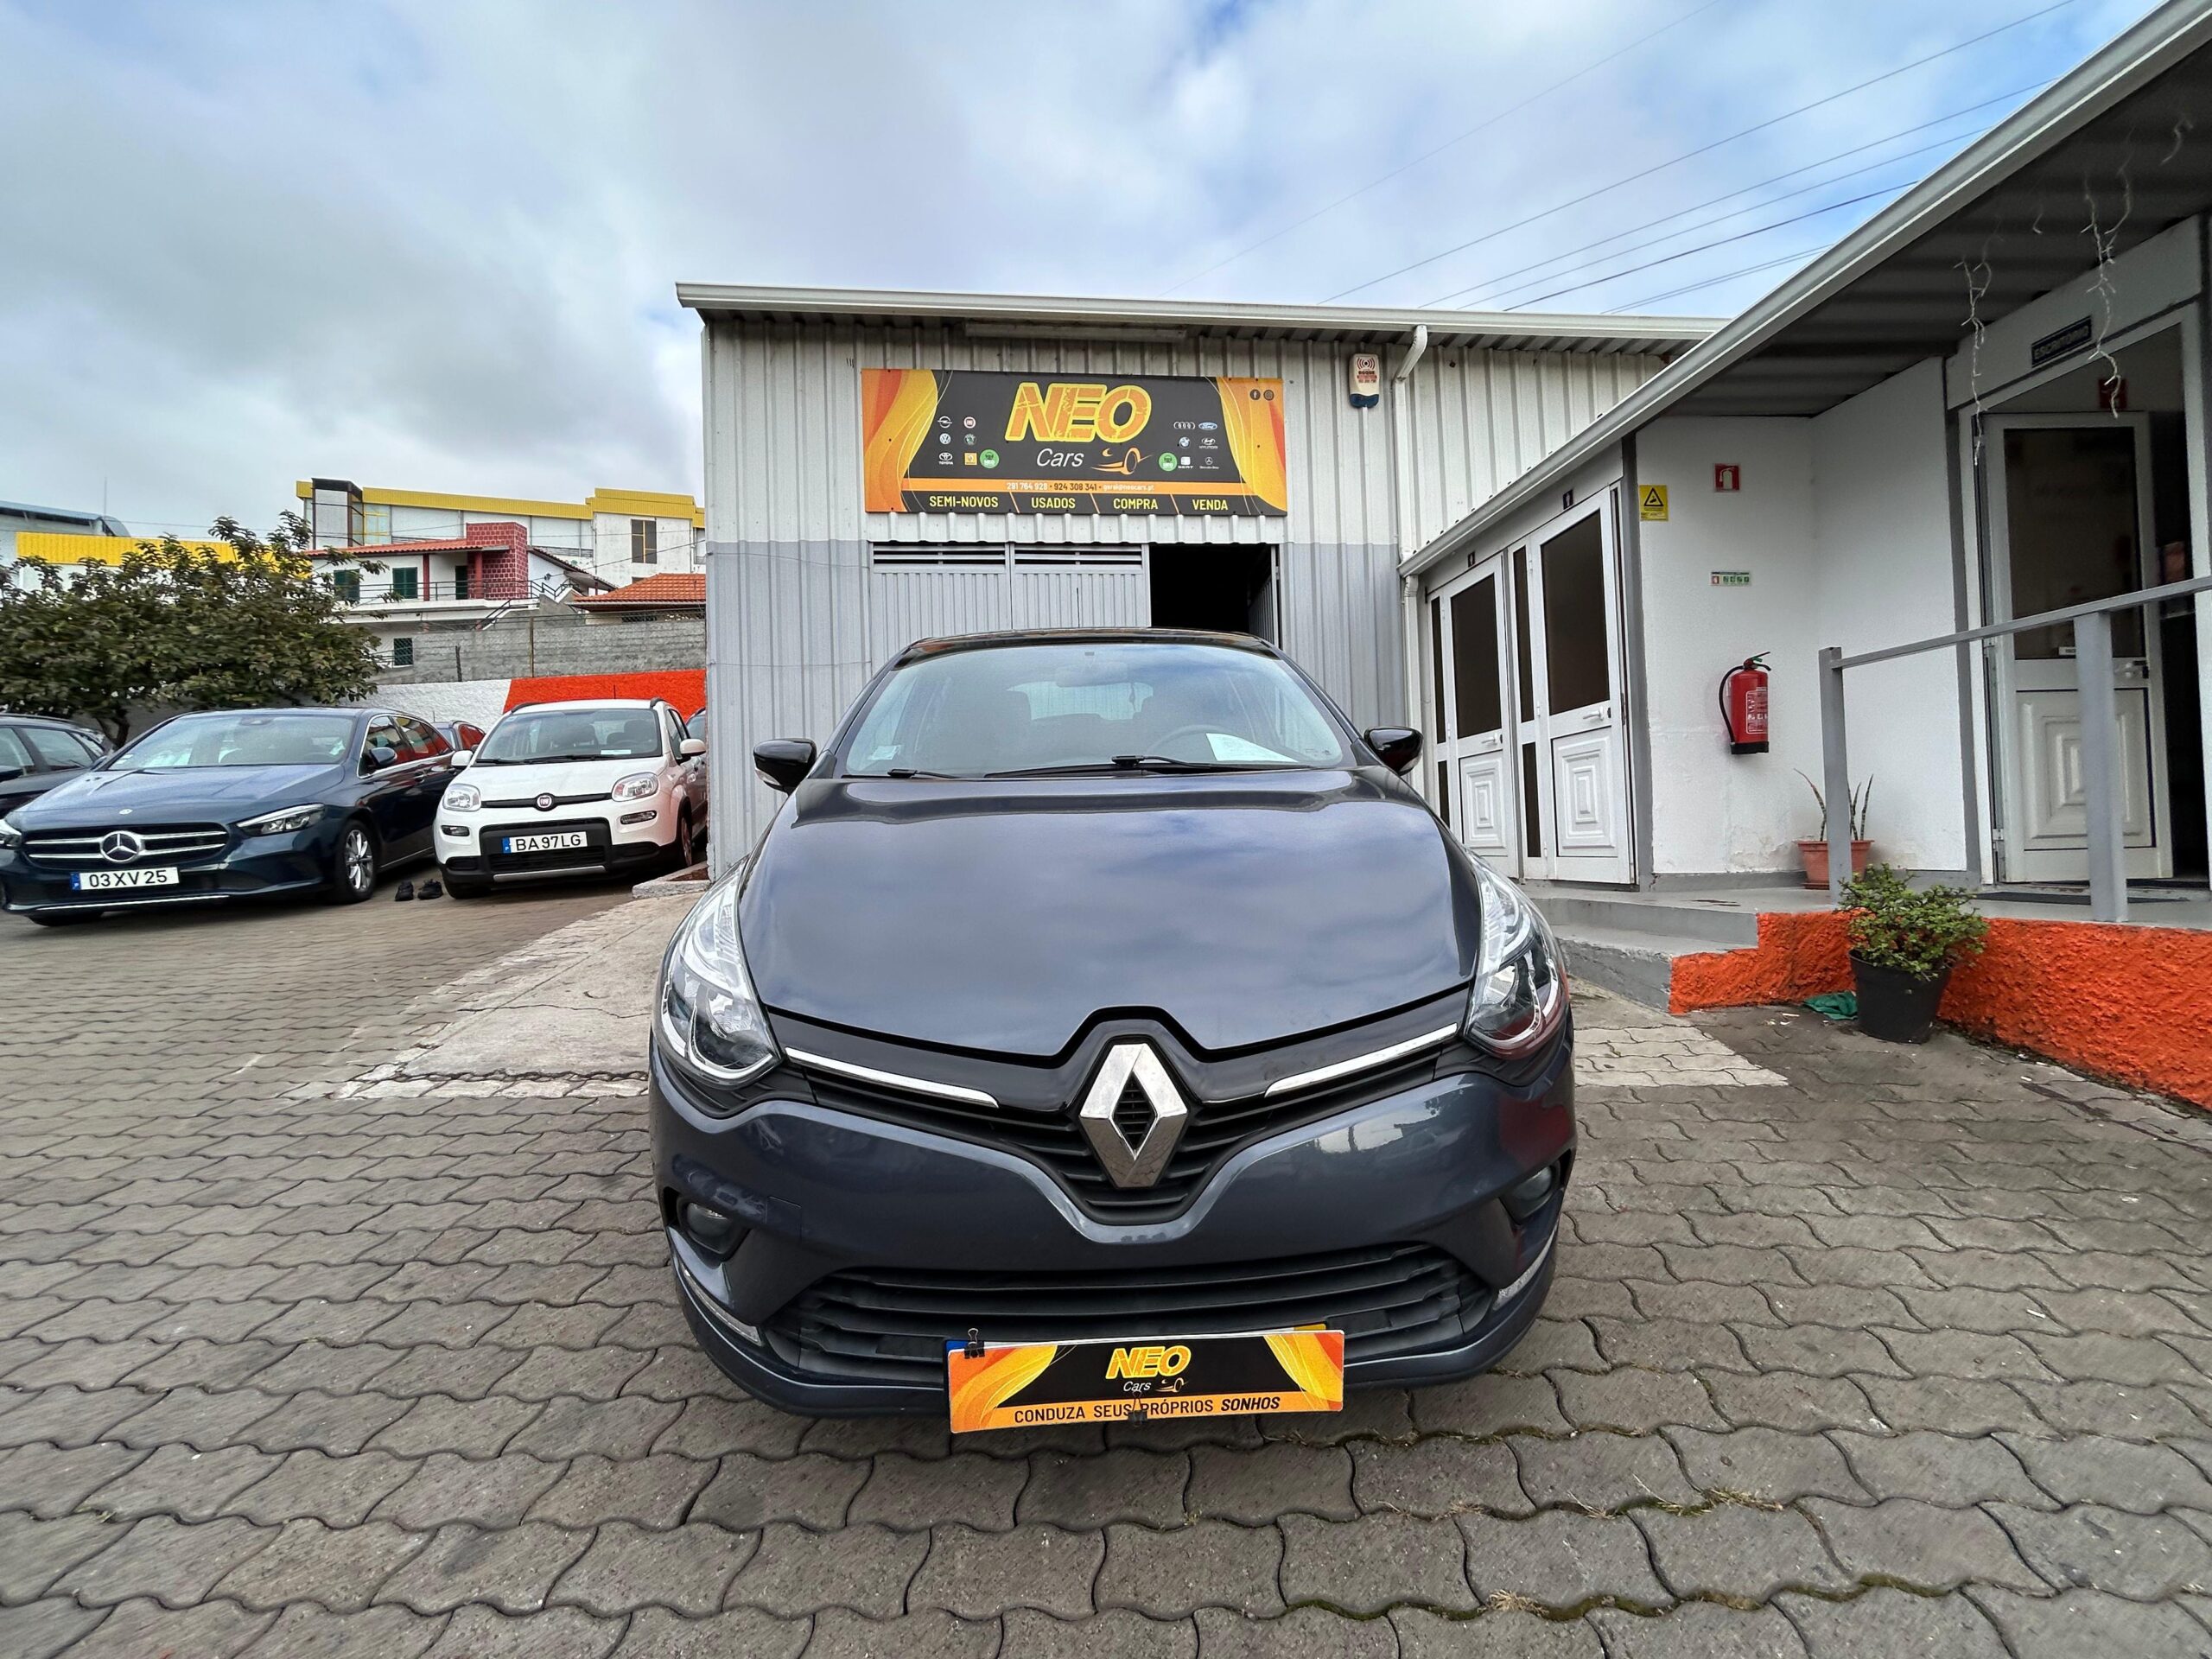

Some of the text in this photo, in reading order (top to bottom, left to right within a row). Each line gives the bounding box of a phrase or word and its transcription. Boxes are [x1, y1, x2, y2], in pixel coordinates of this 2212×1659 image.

[1005, 382, 1152, 442] NEO
[1037, 448, 1084, 467] Cars
[1054, 482, 1068, 491] 924
[929, 496, 999, 508] SEMI-NOVOS
[1031, 497, 1076, 509] USADOS
[1113, 498, 1159, 510] COMPRA
[1192, 499, 1229, 511] VENDA
[1105, 1345, 1192, 1379] NEO
[1123, 1381, 1152, 1392] Cars
[1014, 1396, 1281, 1423] CONDUZA SEUS PRÓPRIOS SONHOS
